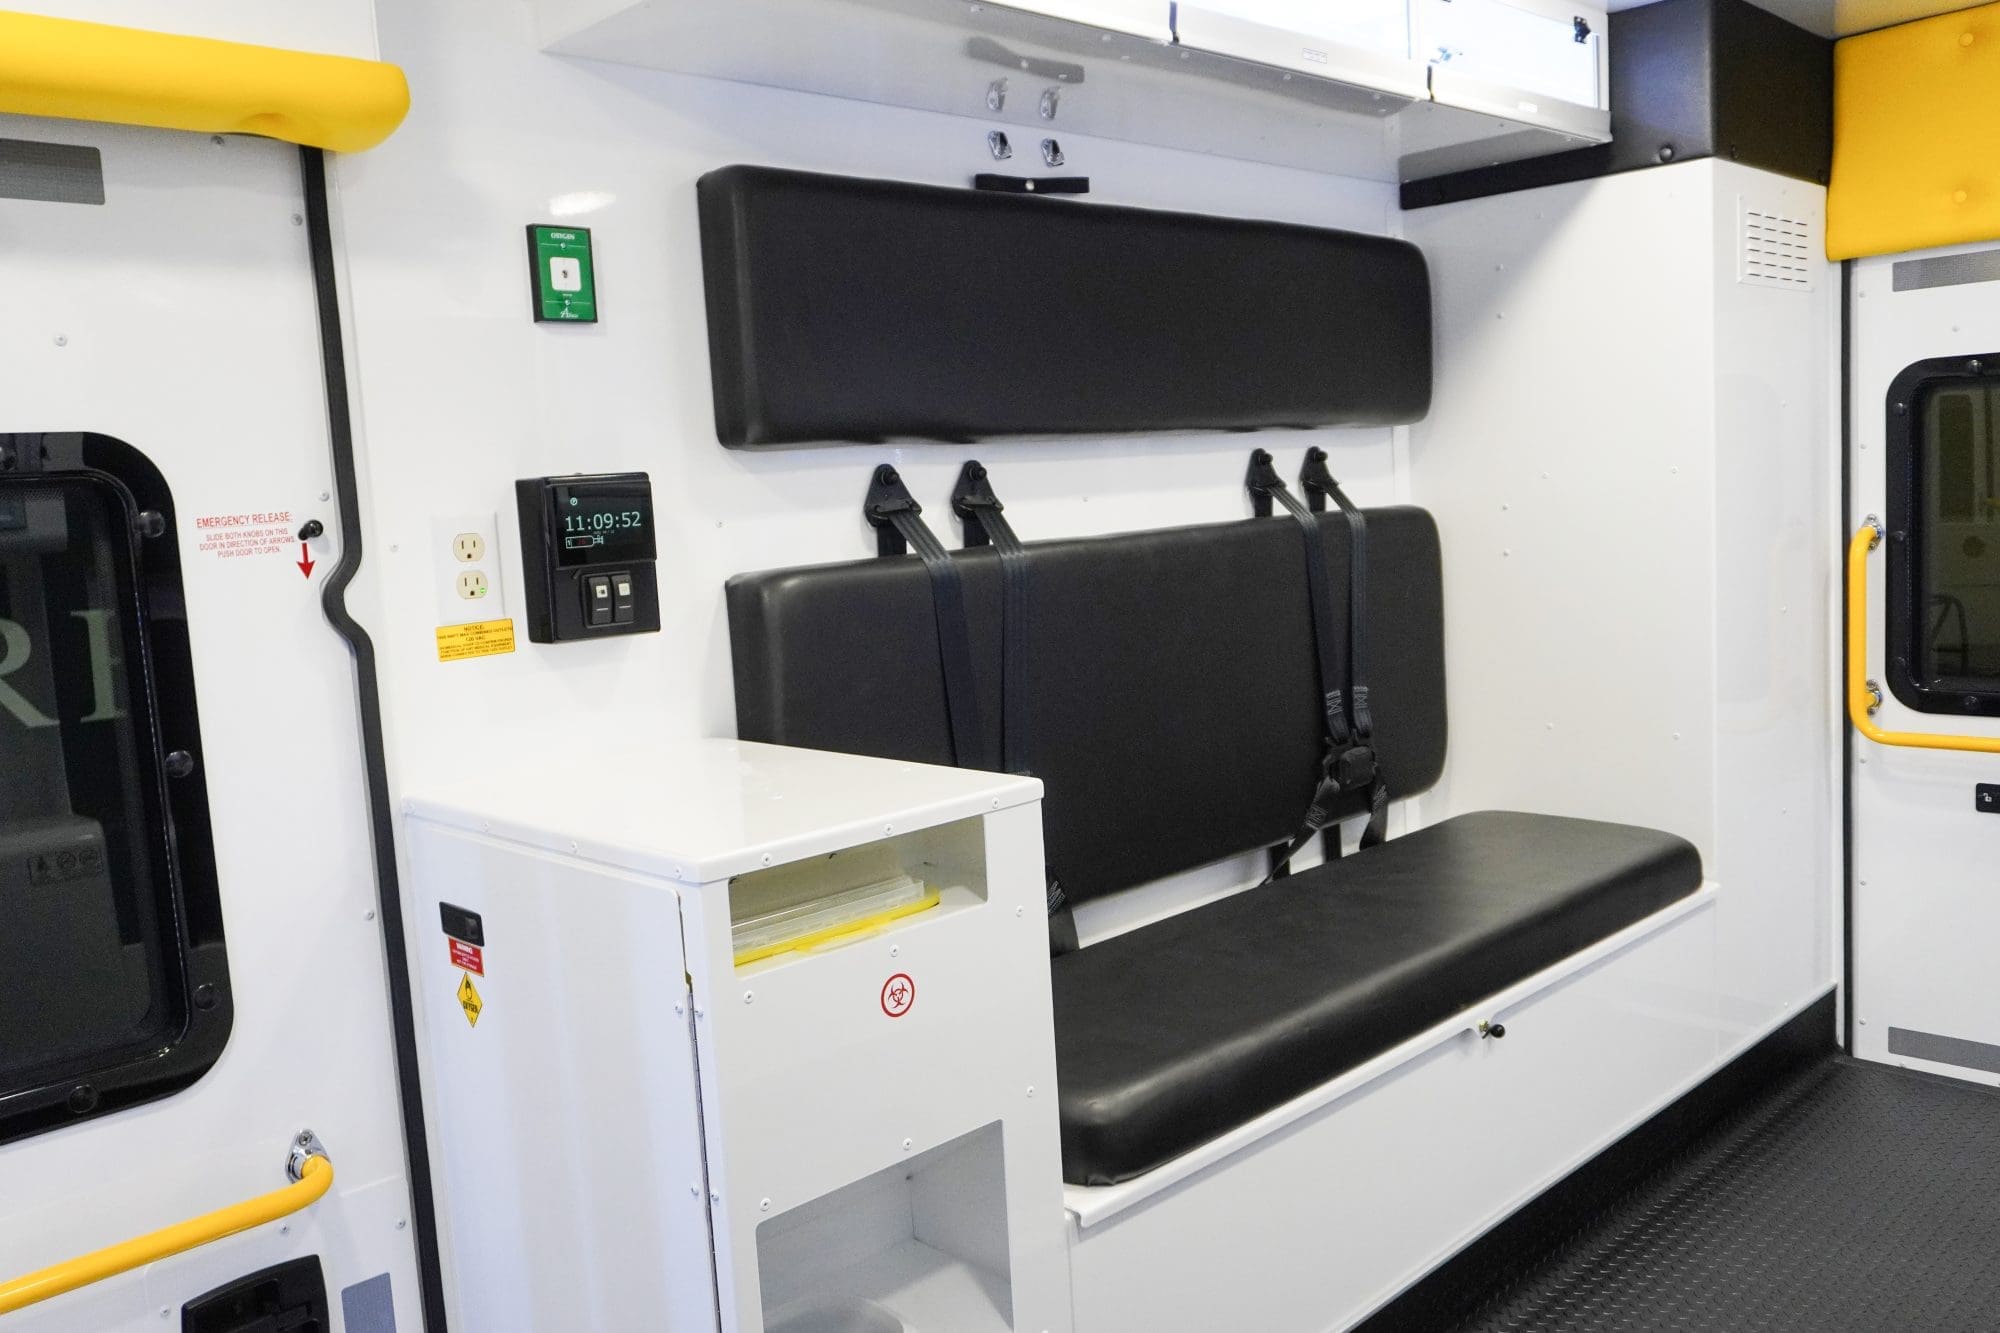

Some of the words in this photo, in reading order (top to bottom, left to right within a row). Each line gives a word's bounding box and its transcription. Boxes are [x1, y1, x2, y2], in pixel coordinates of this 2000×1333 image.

[196, 515, 249, 528] EMERGENCY
[252, 511, 293, 524] RELEASE:
[565, 511, 641, 531] 11:09:52
[206, 533, 223, 541] SLIDE
[225, 531, 241, 540] BOTH
[243, 529, 263, 538] KNOBS
[265, 528, 273, 536] ON
[199, 543, 217, 551] DOOR
[227, 540, 259, 548] DIRECTION
[217, 549, 234, 558] PUSH
[236, 548, 253, 556] DOOR
